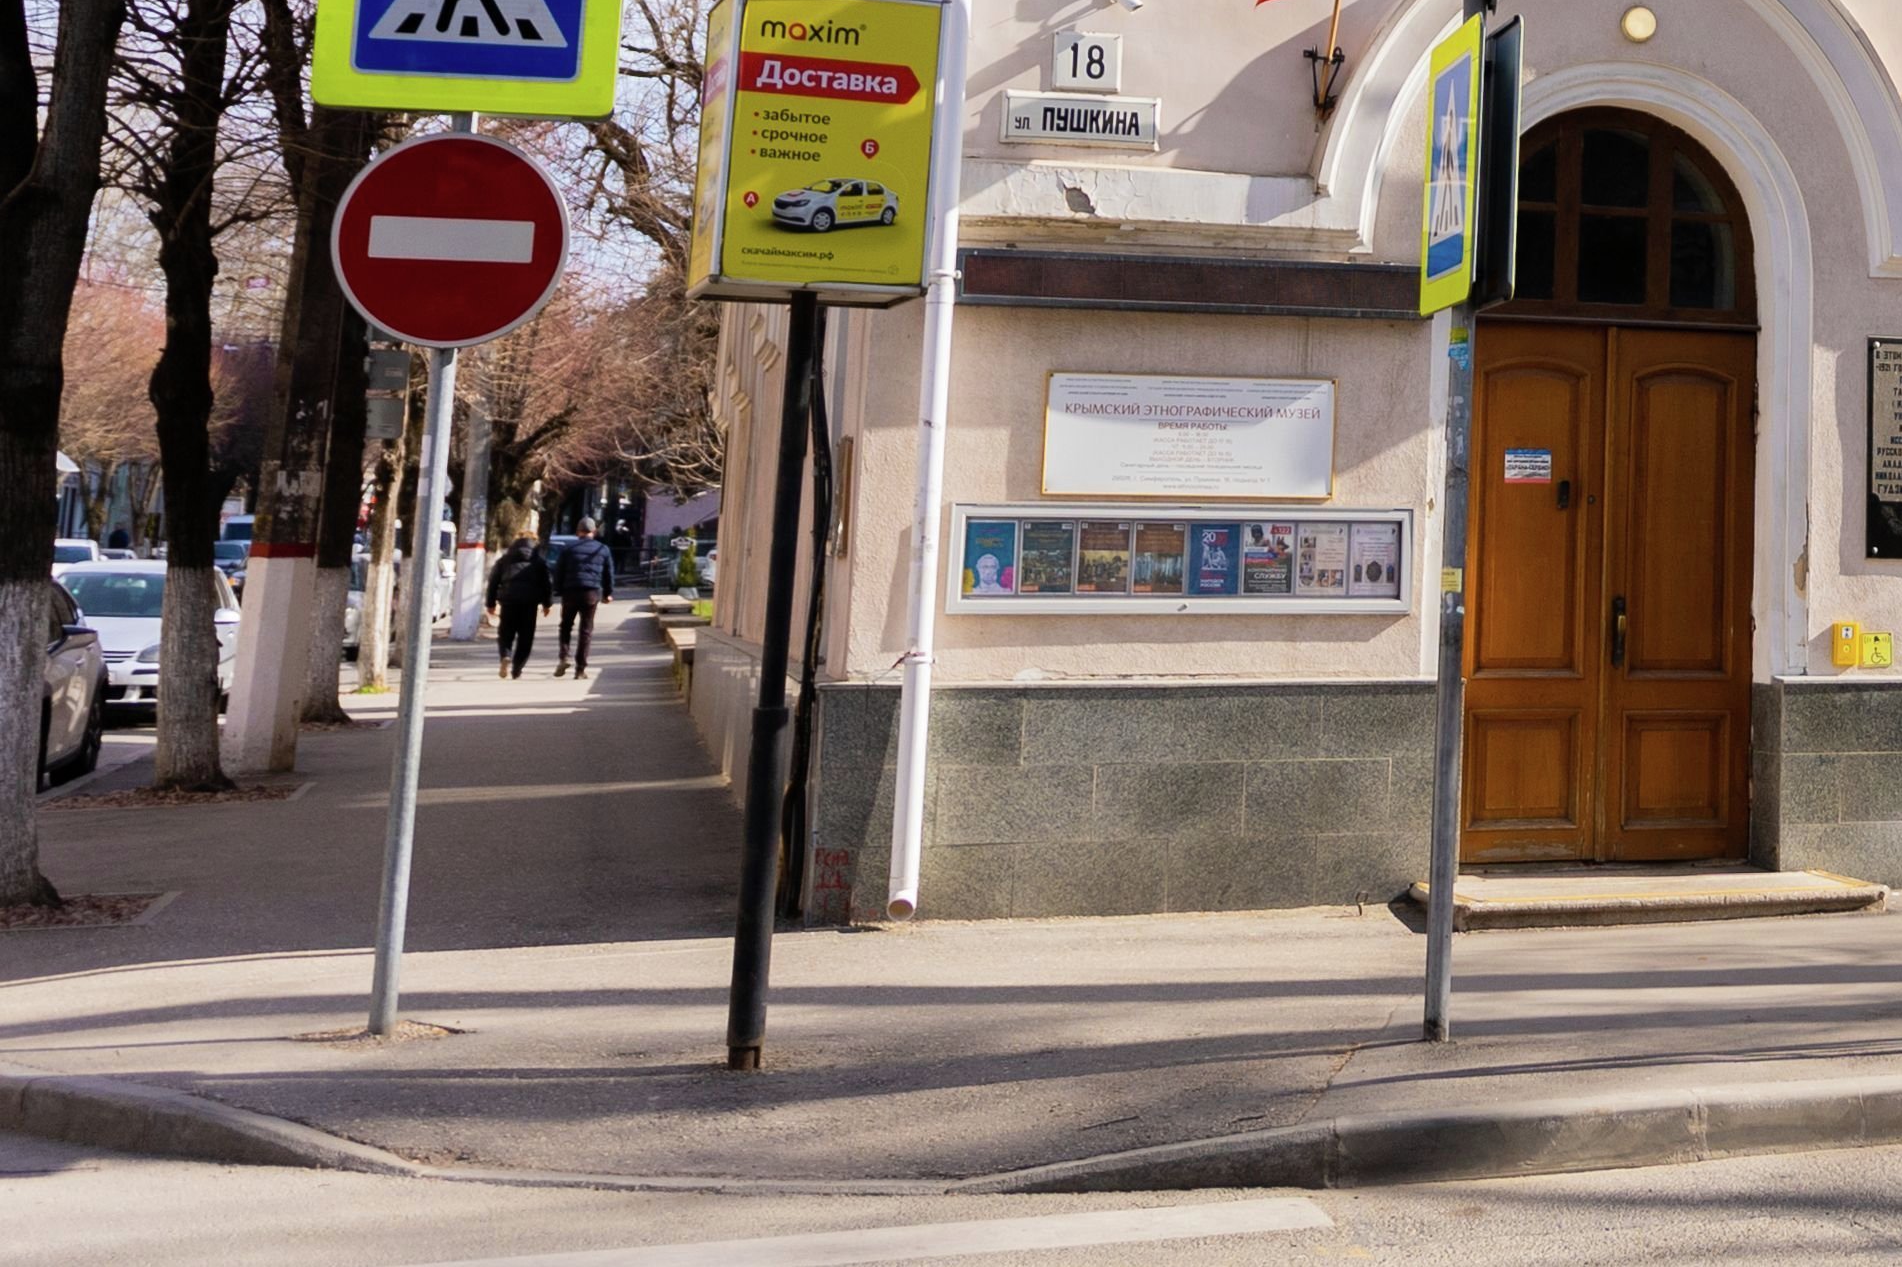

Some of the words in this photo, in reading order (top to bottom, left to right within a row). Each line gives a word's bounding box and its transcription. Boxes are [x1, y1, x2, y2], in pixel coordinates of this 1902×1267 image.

[761, 20, 860, 46] maxim
[1071, 42, 1105, 79] 18
[756, 59, 899, 95] Доставка
[762, 109, 831, 125] забытое
[1042, 106, 1140, 137] ПУШКИНА
[761, 128, 828, 144] срочное
[759, 147, 821, 162] важное
[1883, 351, 1902, 360] ЭТОМ
[1065, 403, 1140, 416] КРЫМСКИЙ
[1143, 405, 1273, 418] ЭТНОГРАФИЧЕСКИЙ
[1275, 407, 1321, 419] МУЗЕЙ
[1158, 421, 1189, 429] ВРЕМЯ
